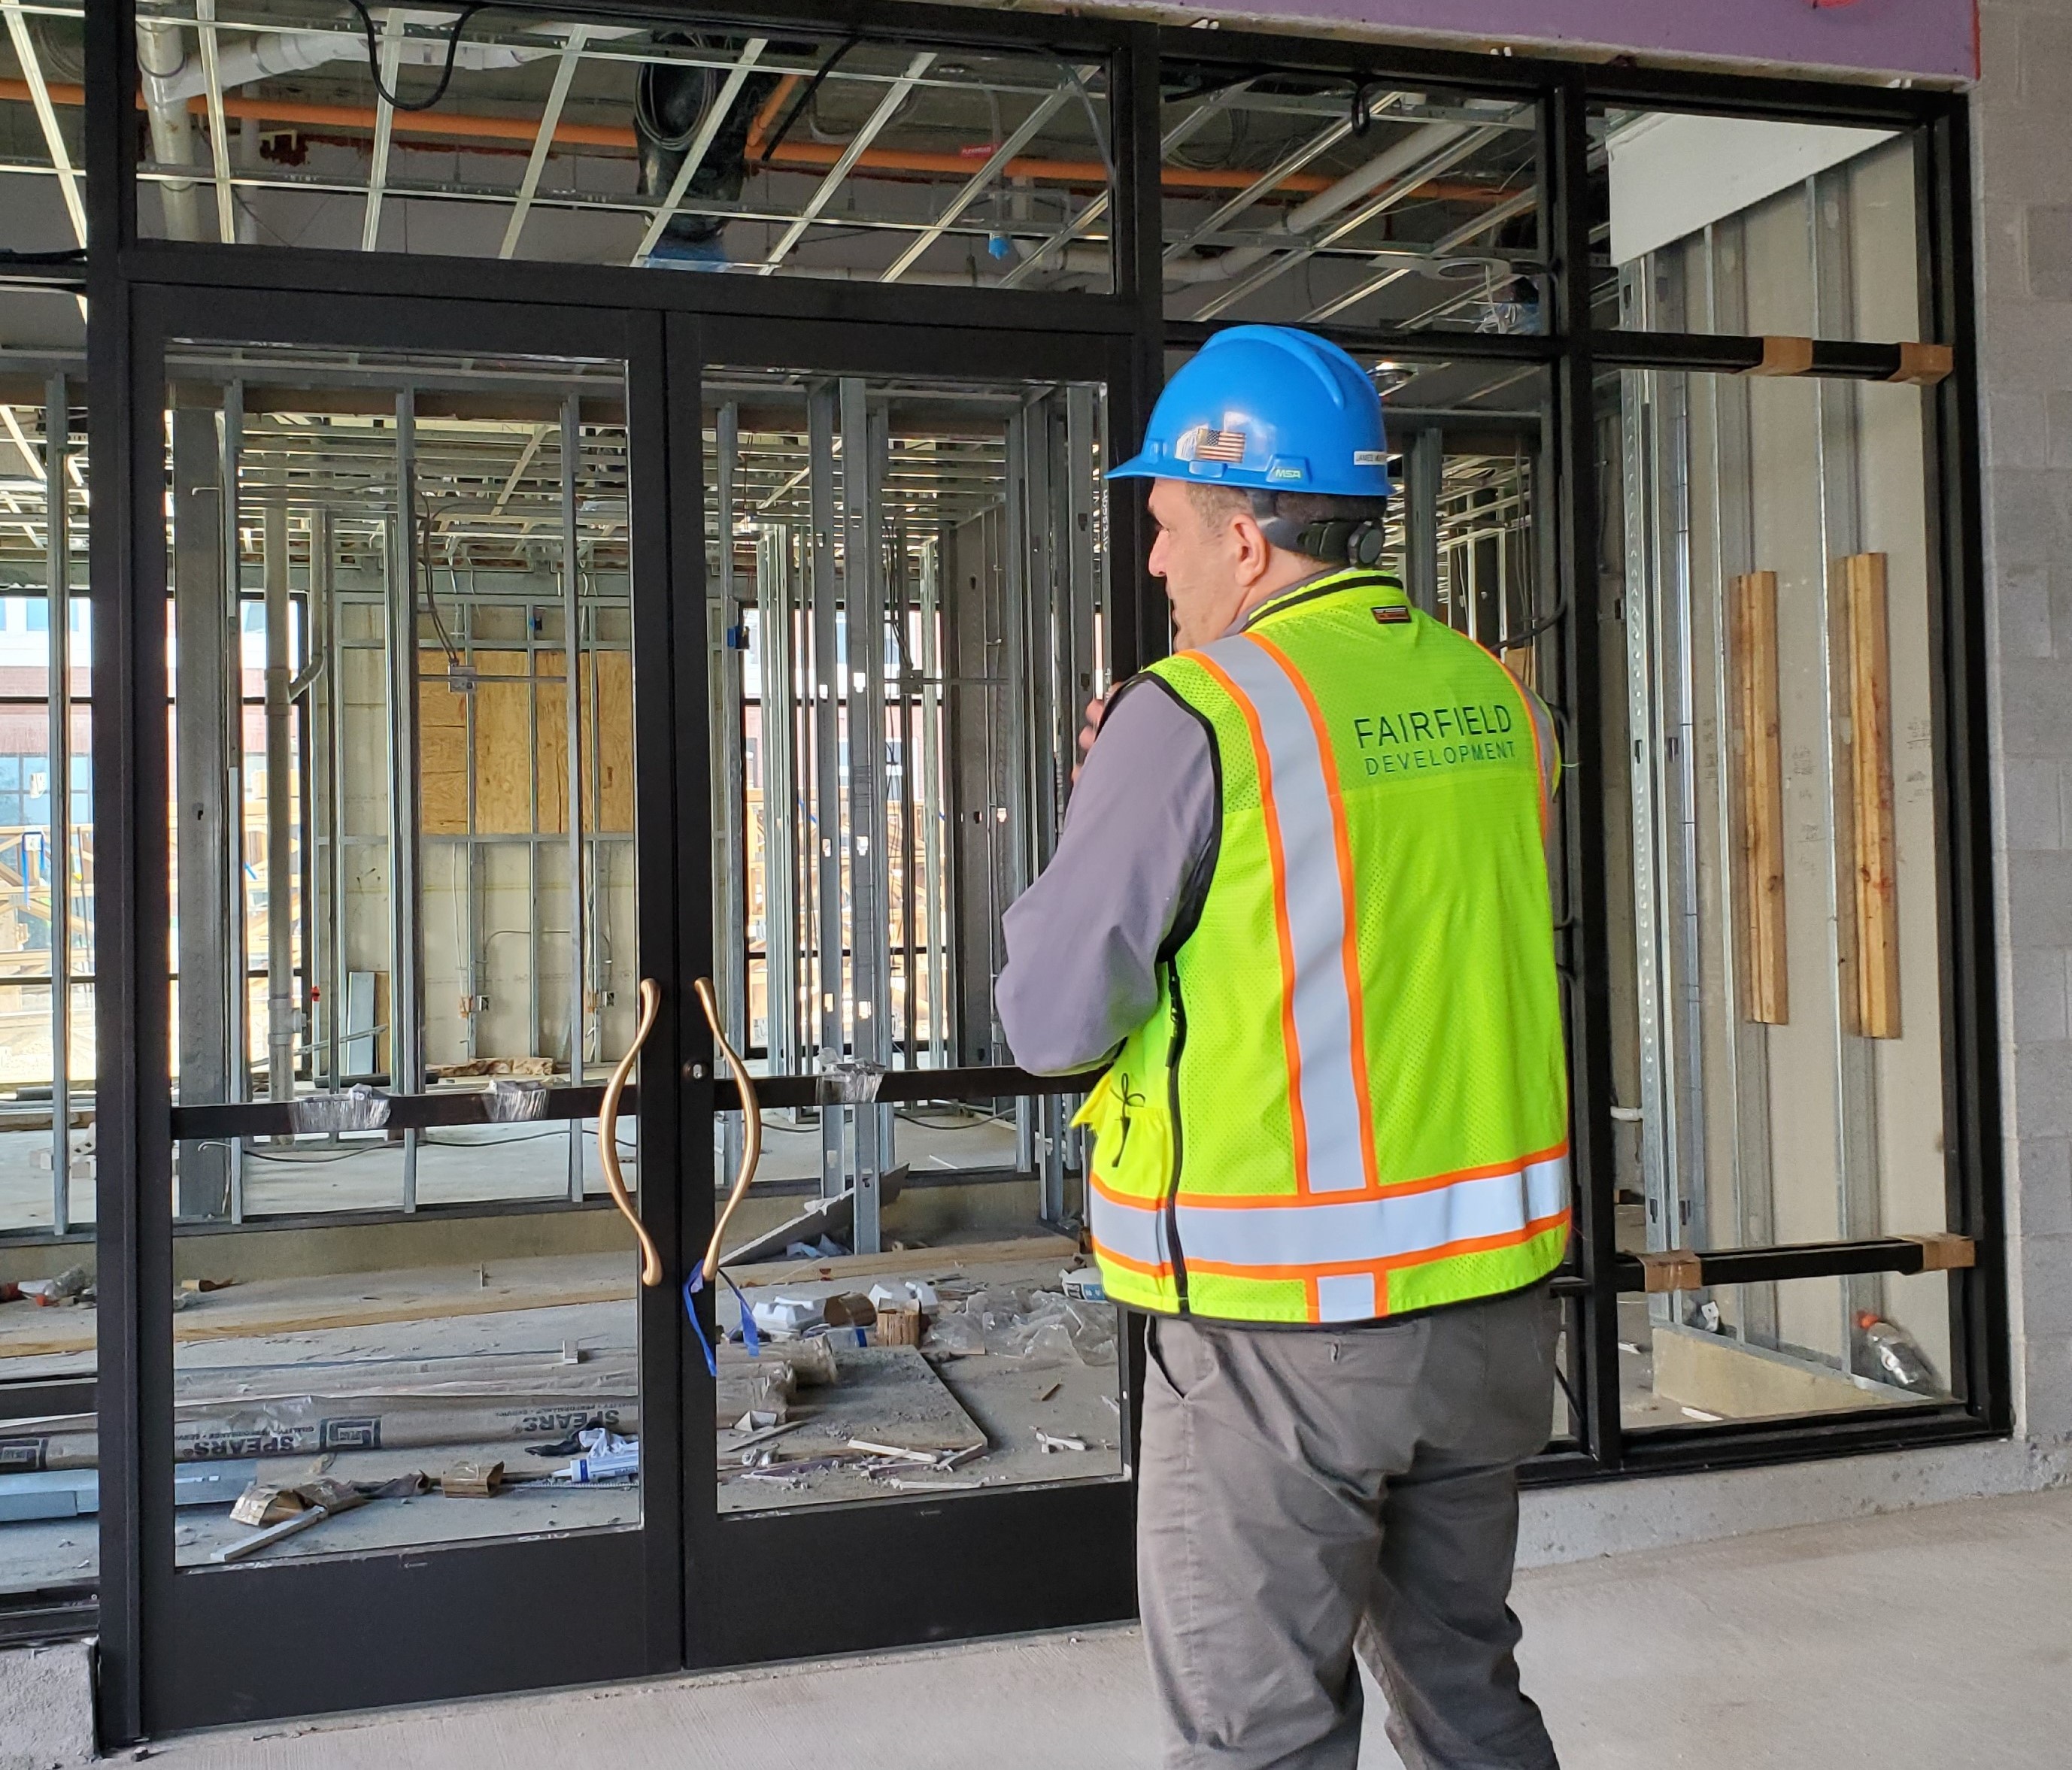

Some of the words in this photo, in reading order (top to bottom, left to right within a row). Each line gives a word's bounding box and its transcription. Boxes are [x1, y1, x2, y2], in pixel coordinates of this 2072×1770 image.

[1275, 468, 1301, 479] MSA
[1354, 705, 1512, 749] FAIRFIELD
[1364, 741, 1516, 776] DEVELOPMENT
